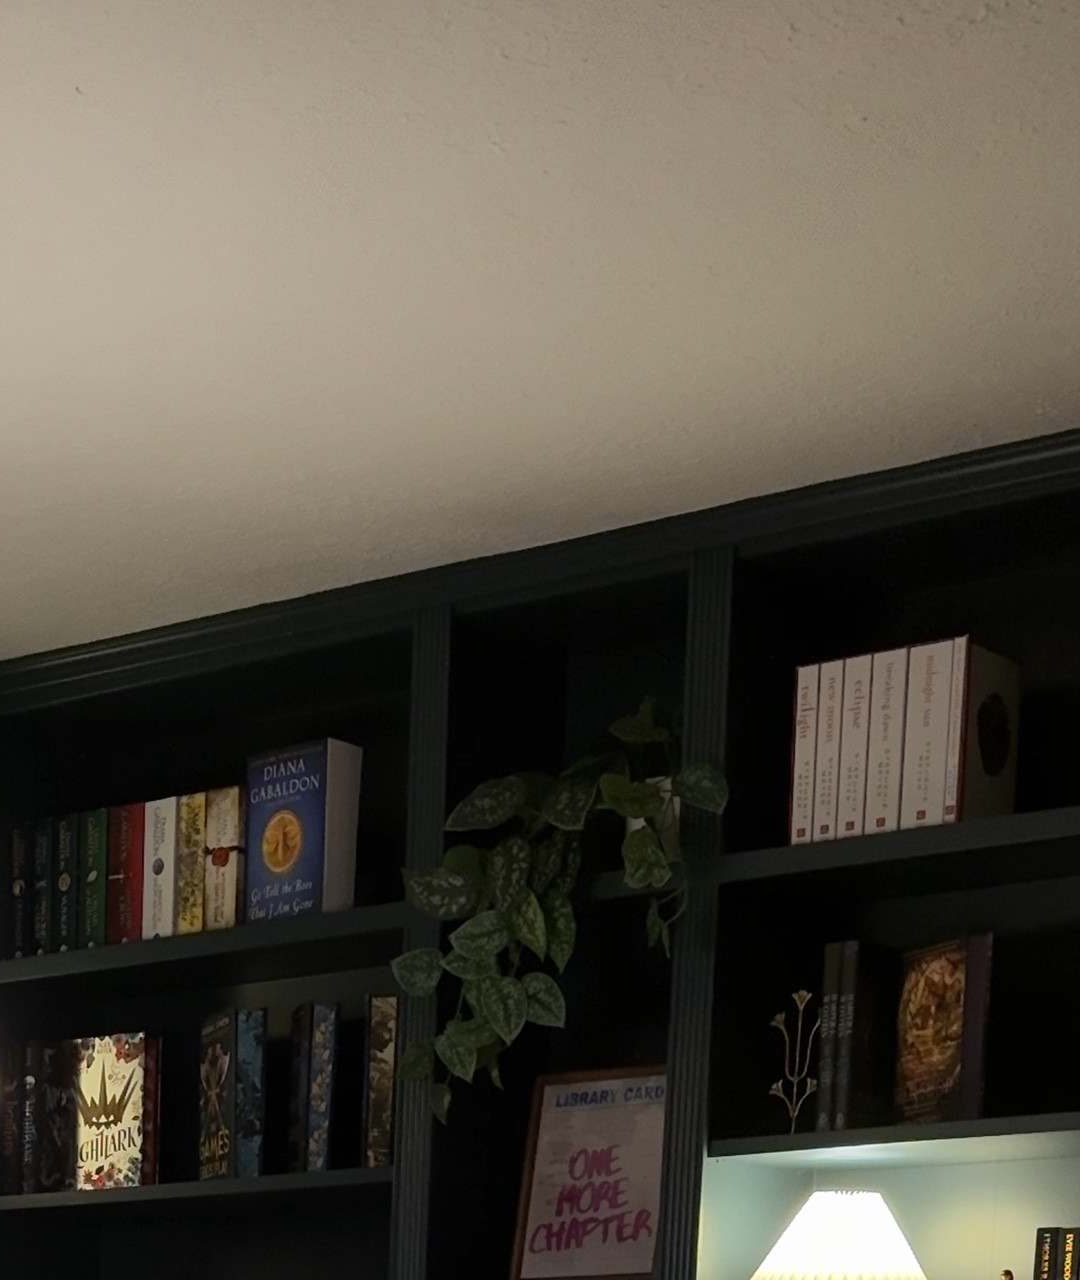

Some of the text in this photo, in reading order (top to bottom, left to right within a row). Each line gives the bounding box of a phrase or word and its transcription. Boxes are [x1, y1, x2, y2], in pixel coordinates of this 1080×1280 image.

[825, 676, 837, 744] new moon
[848, 680, 865, 730] eclipse
[881, 662, 894, 741] breaking dawn
[921, 655, 939, 729] midnight sun
[797, 686, 815, 741] twilight
[250, 774, 320, 804] GABALDON
[263, 758, 306, 782] DIANA
[249, 906, 266, 921] That
[292, 897, 314, 916] Gone
[251, 878, 314, 906] Go Tell the Bees
[555, 1085, 665, 1108] LIBRARY CARD
[568, 1143, 623, 1181] ONE
[555, 1177, 629, 1217] MORE
[528, 1208, 653, 1254] CHAPTER
